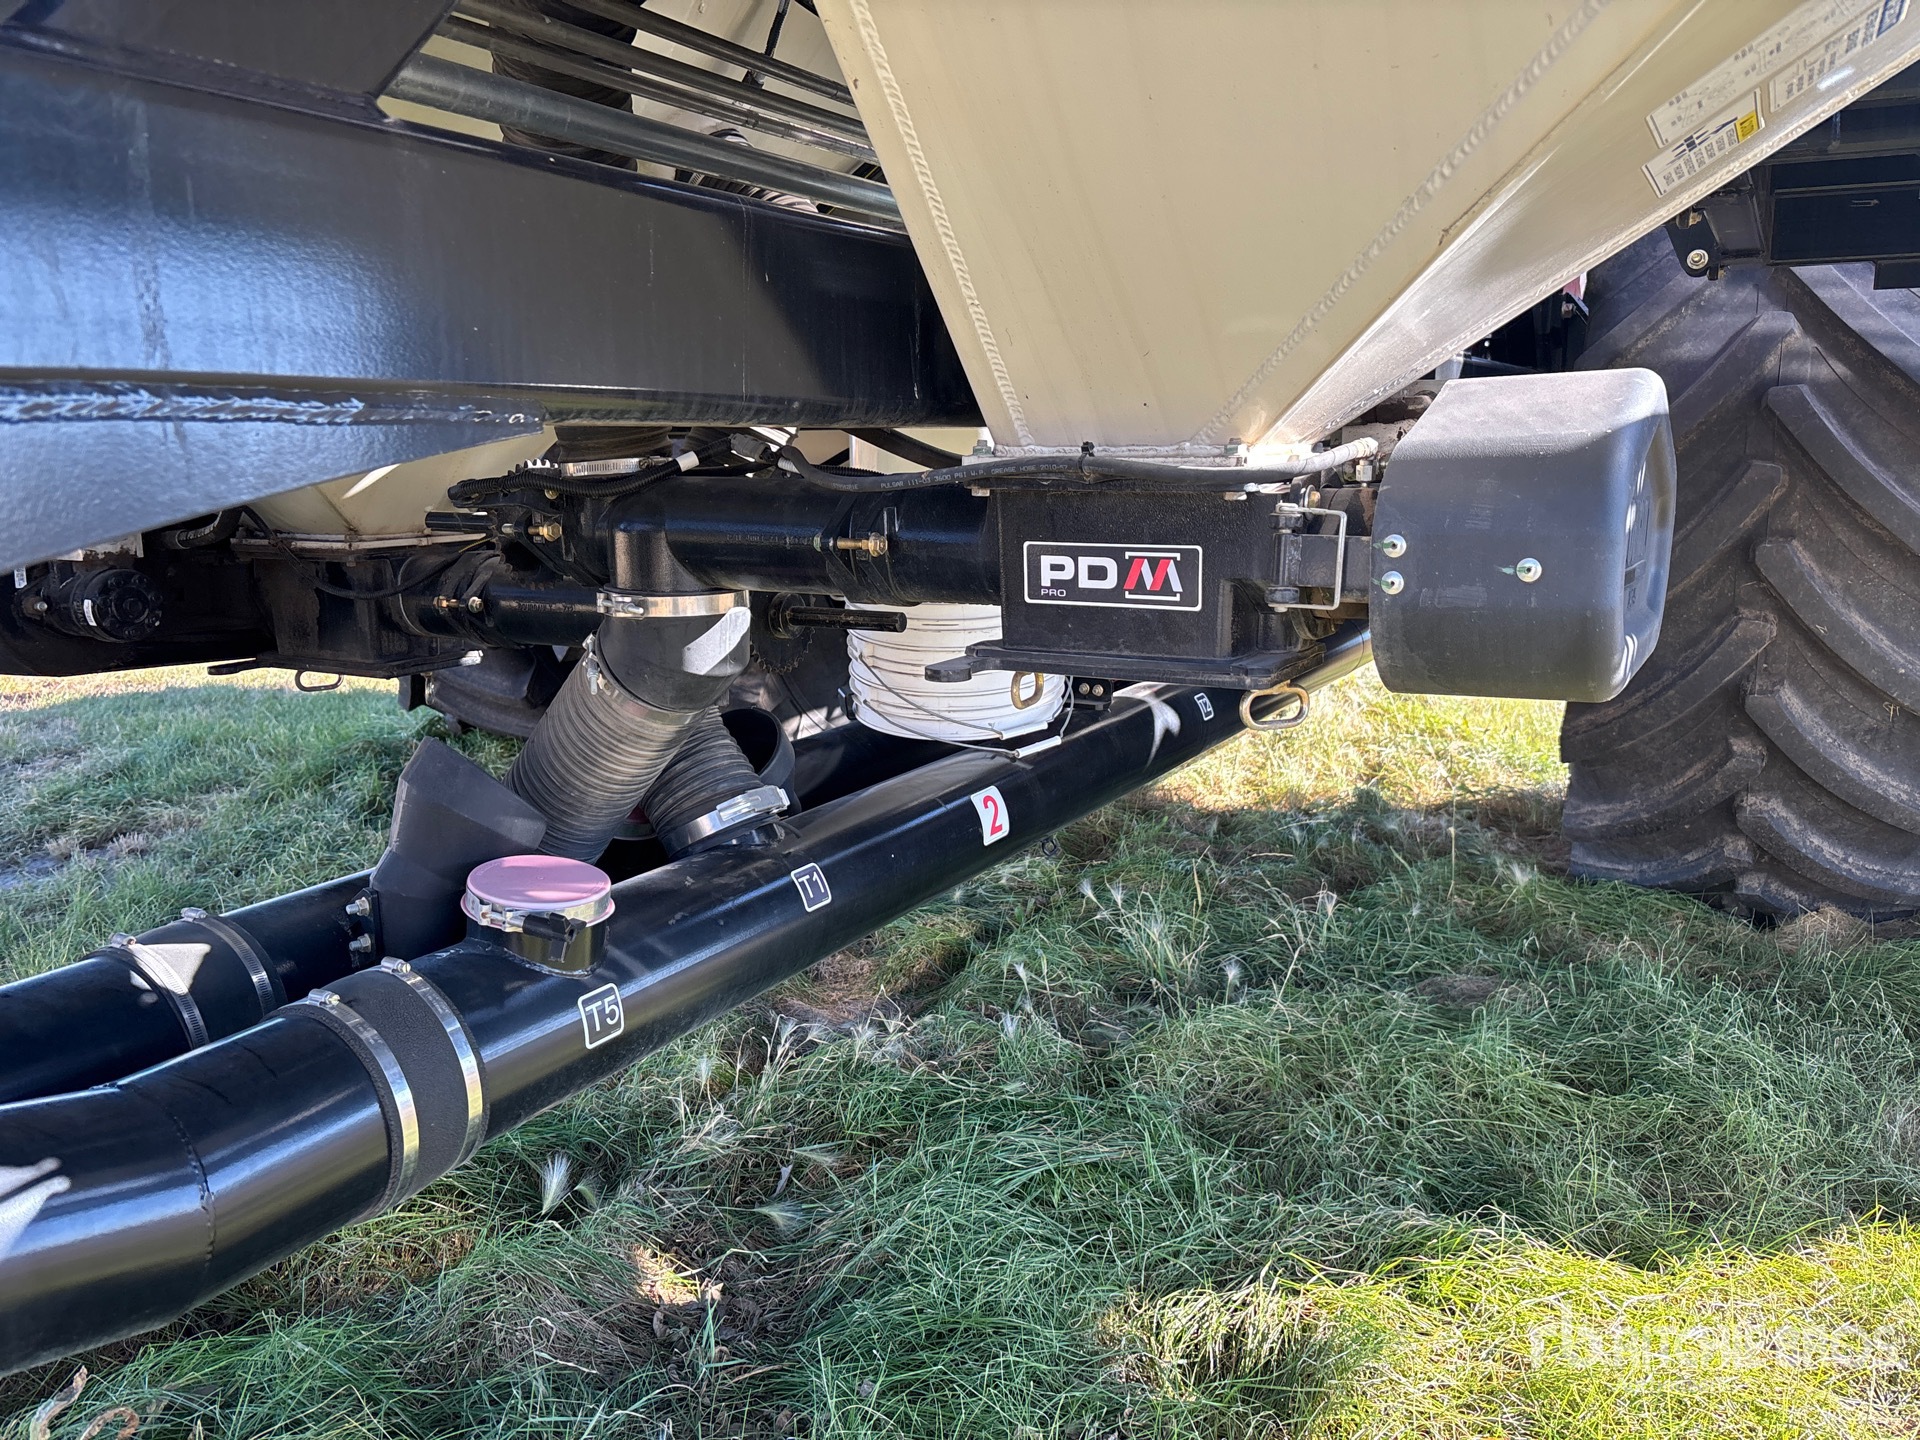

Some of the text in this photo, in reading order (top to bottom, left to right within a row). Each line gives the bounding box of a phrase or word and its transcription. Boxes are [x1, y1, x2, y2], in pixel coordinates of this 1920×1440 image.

[880, 480, 904, 489] PULSAR
[934, 474, 952, 482] 3600
[1041, 554, 1183, 593] PDM
[1041, 588, 1066, 597] PRO
[983, 795, 1003, 837] 2
[798, 871, 825, 898] T1
[584, 994, 620, 1032] T5
